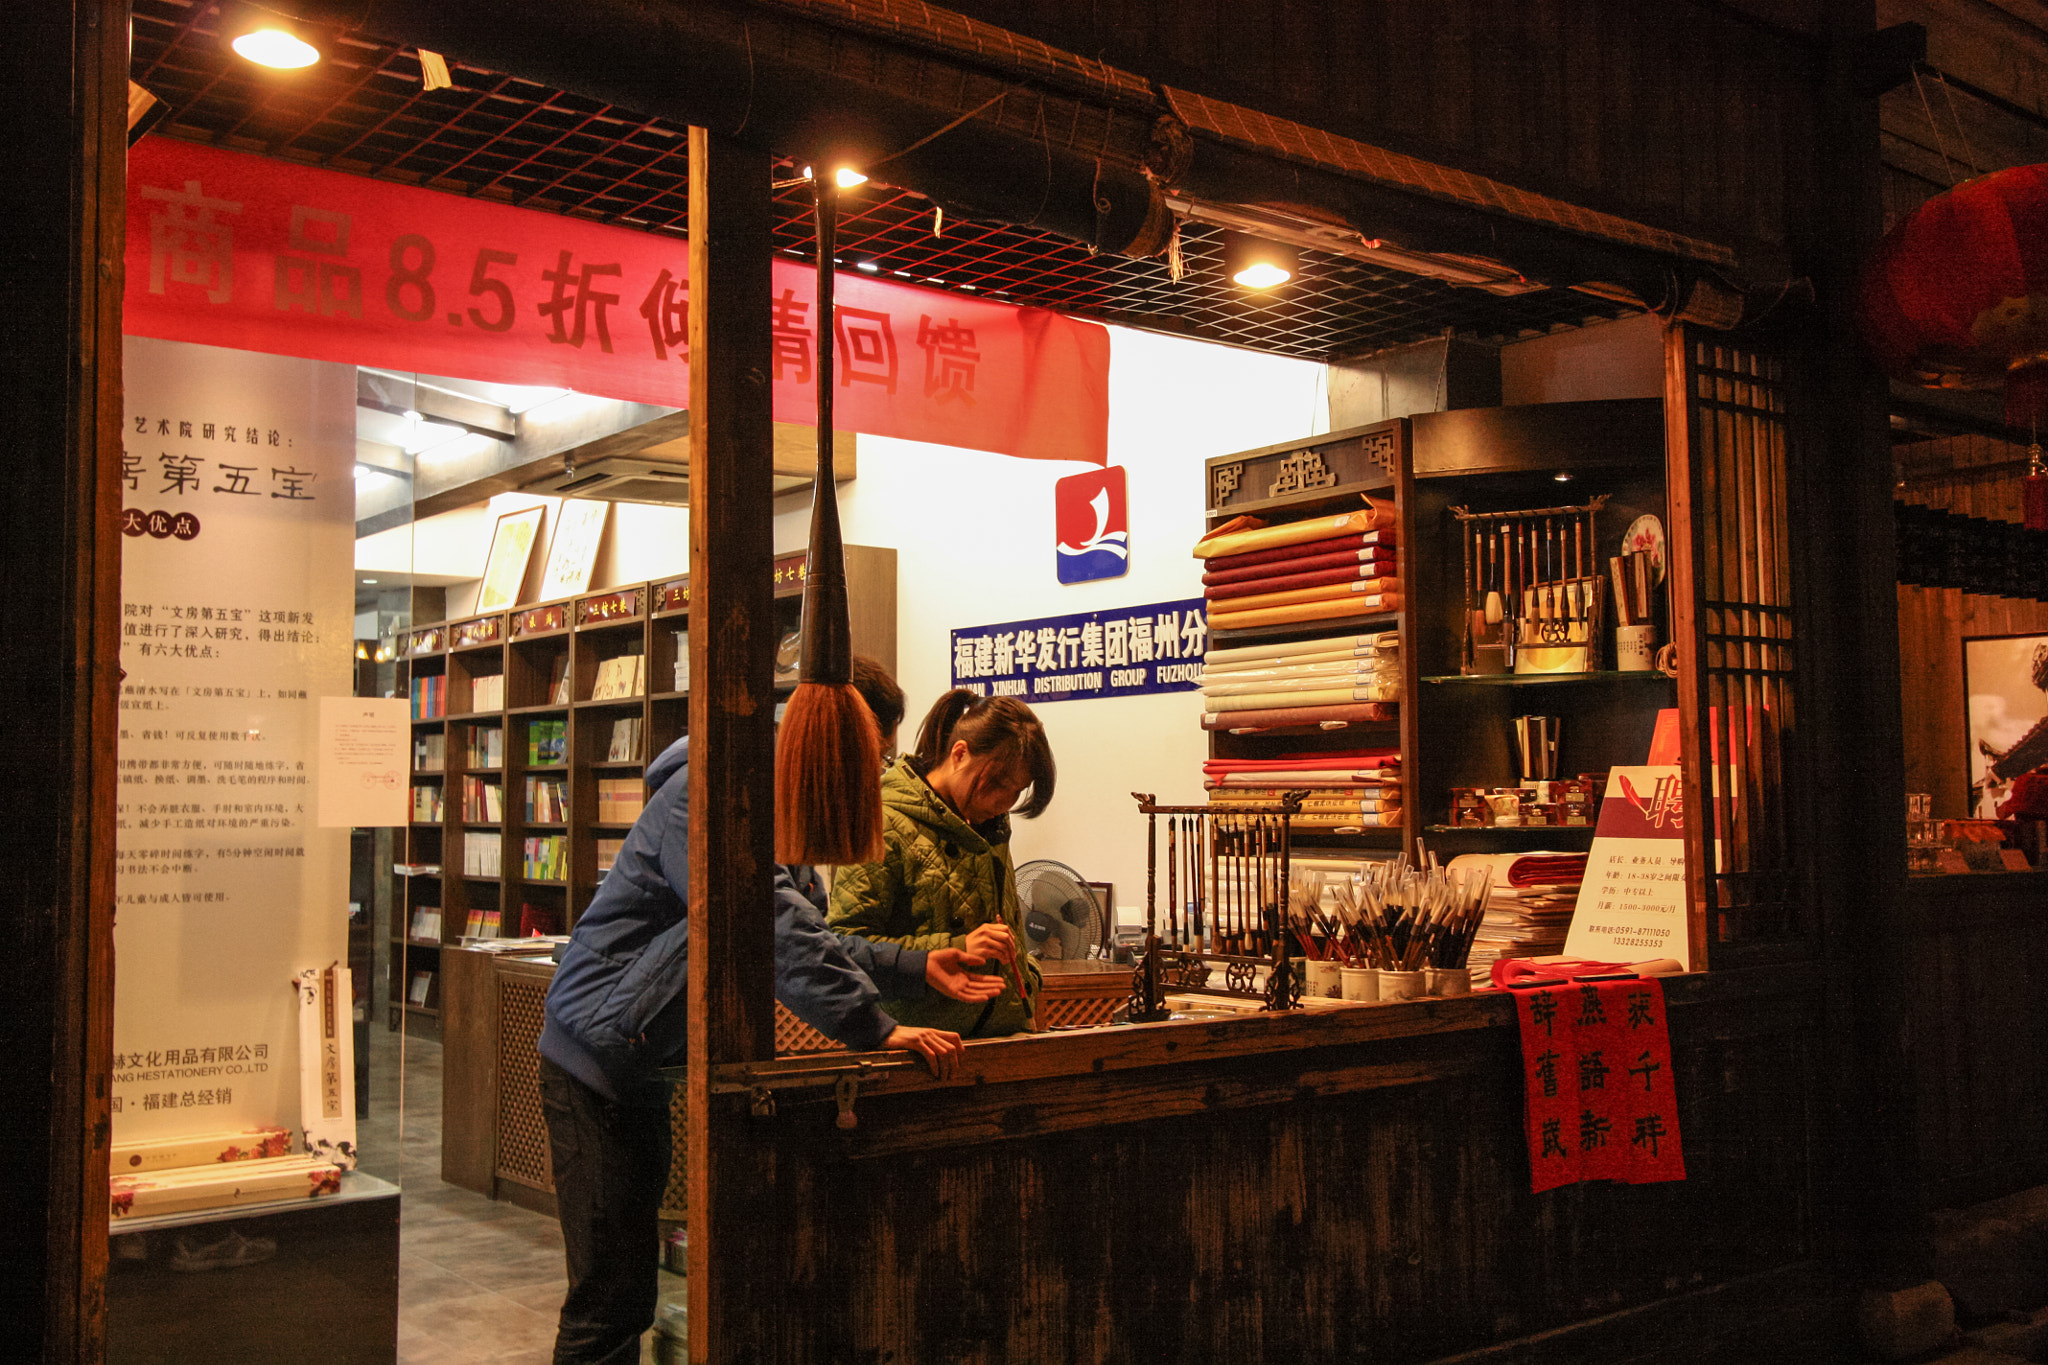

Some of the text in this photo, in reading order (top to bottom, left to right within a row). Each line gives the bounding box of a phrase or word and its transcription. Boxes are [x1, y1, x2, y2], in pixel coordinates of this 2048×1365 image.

[123, 513, 192, 535] 大优点
[991, 678, 1028, 697] XINHUA
[1034, 671, 1102, 694] DISTRIBUTION
[1110, 667, 1147, 687] GROUP
[1156, 662, 1204, 685] FUZHOU
[137, 1066, 223, 1081] HESTATIONERY
